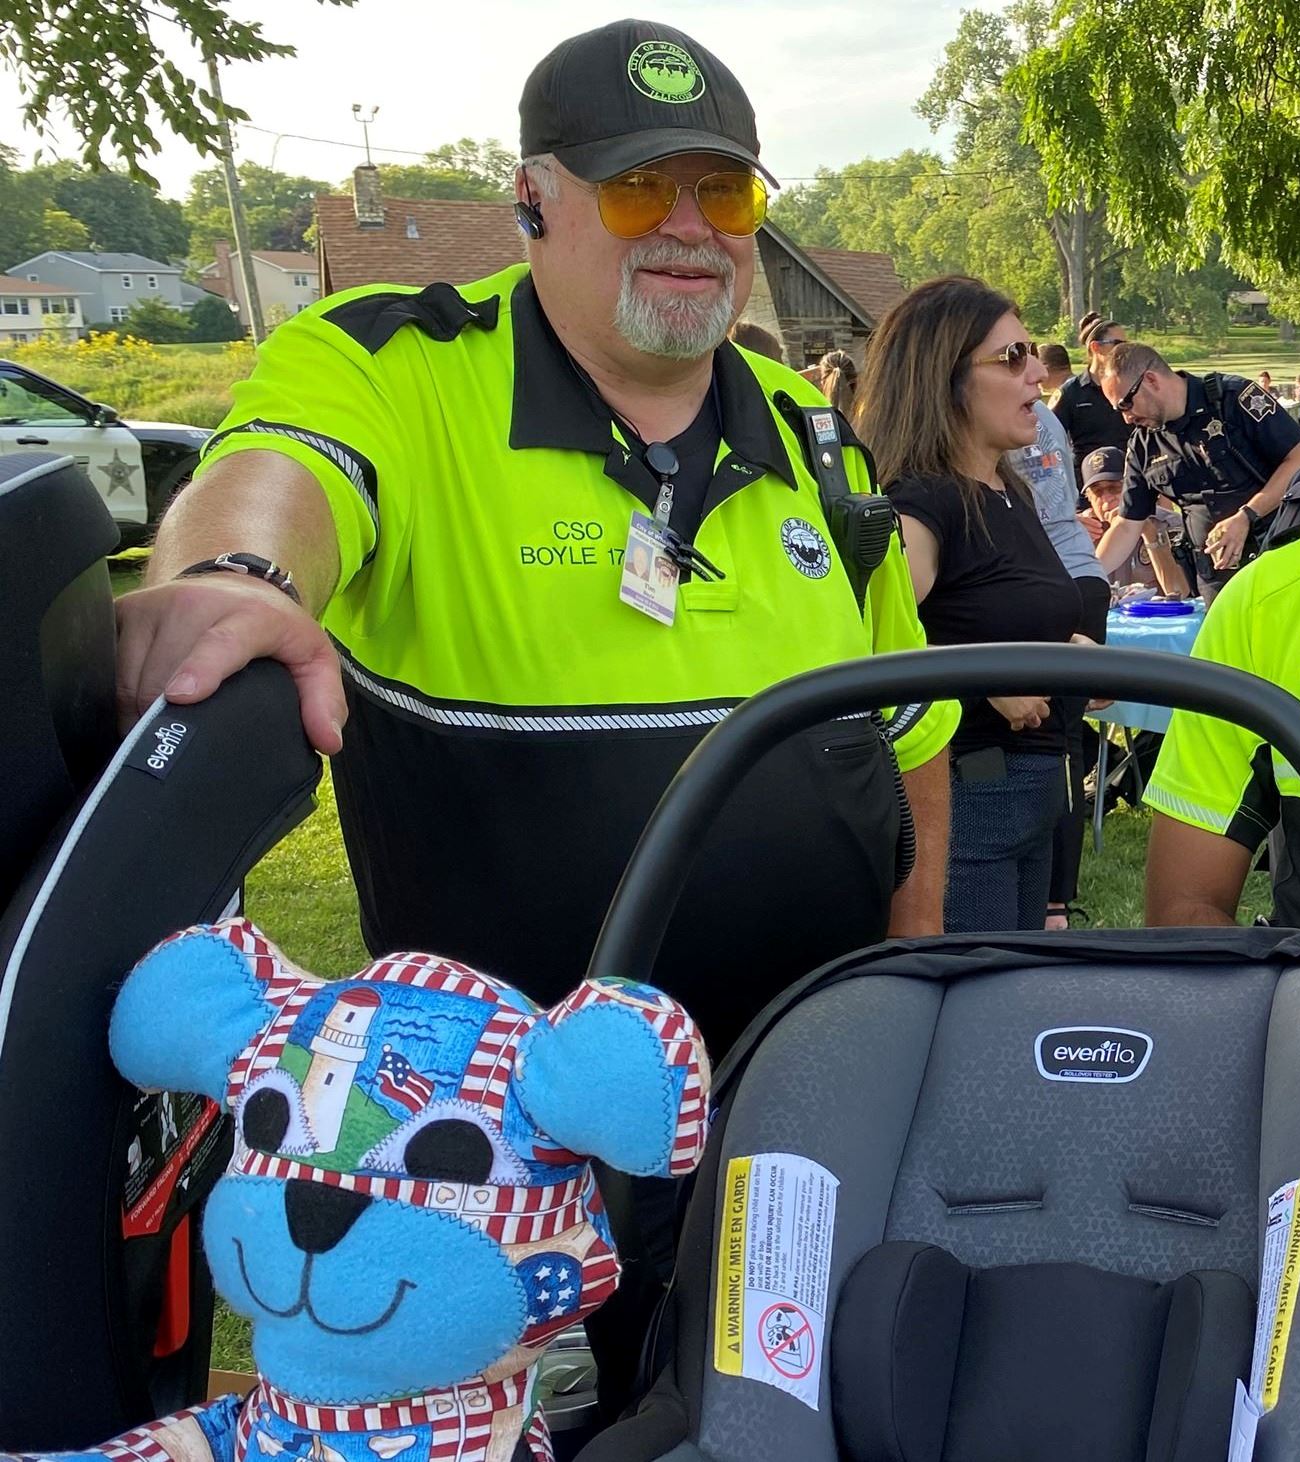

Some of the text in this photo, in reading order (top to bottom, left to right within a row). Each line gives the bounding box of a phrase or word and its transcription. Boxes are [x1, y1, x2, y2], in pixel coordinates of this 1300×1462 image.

[553, 521, 603, 541] CSO
[520, 546, 597, 566] BOYLE
[147, 723, 187, 769] evenflo
[1054, 1041, 1134, 1063] evenflo
[732, 1173, 746, 1213] GARDE
[731, 1218, 742, 1232] EN
[767, 1204, 775, 1225] INJURY
[730, 1237, 741, 1265] MISE
[766, 1256, 772, 1265] OR
[749, 1277, 754, 1287] DO
[728, 1275, 740, 1337] WARNING
[1274, 1321, 1283, 1339] EN
[1265, 1345, 1279, 1395] GARDE
